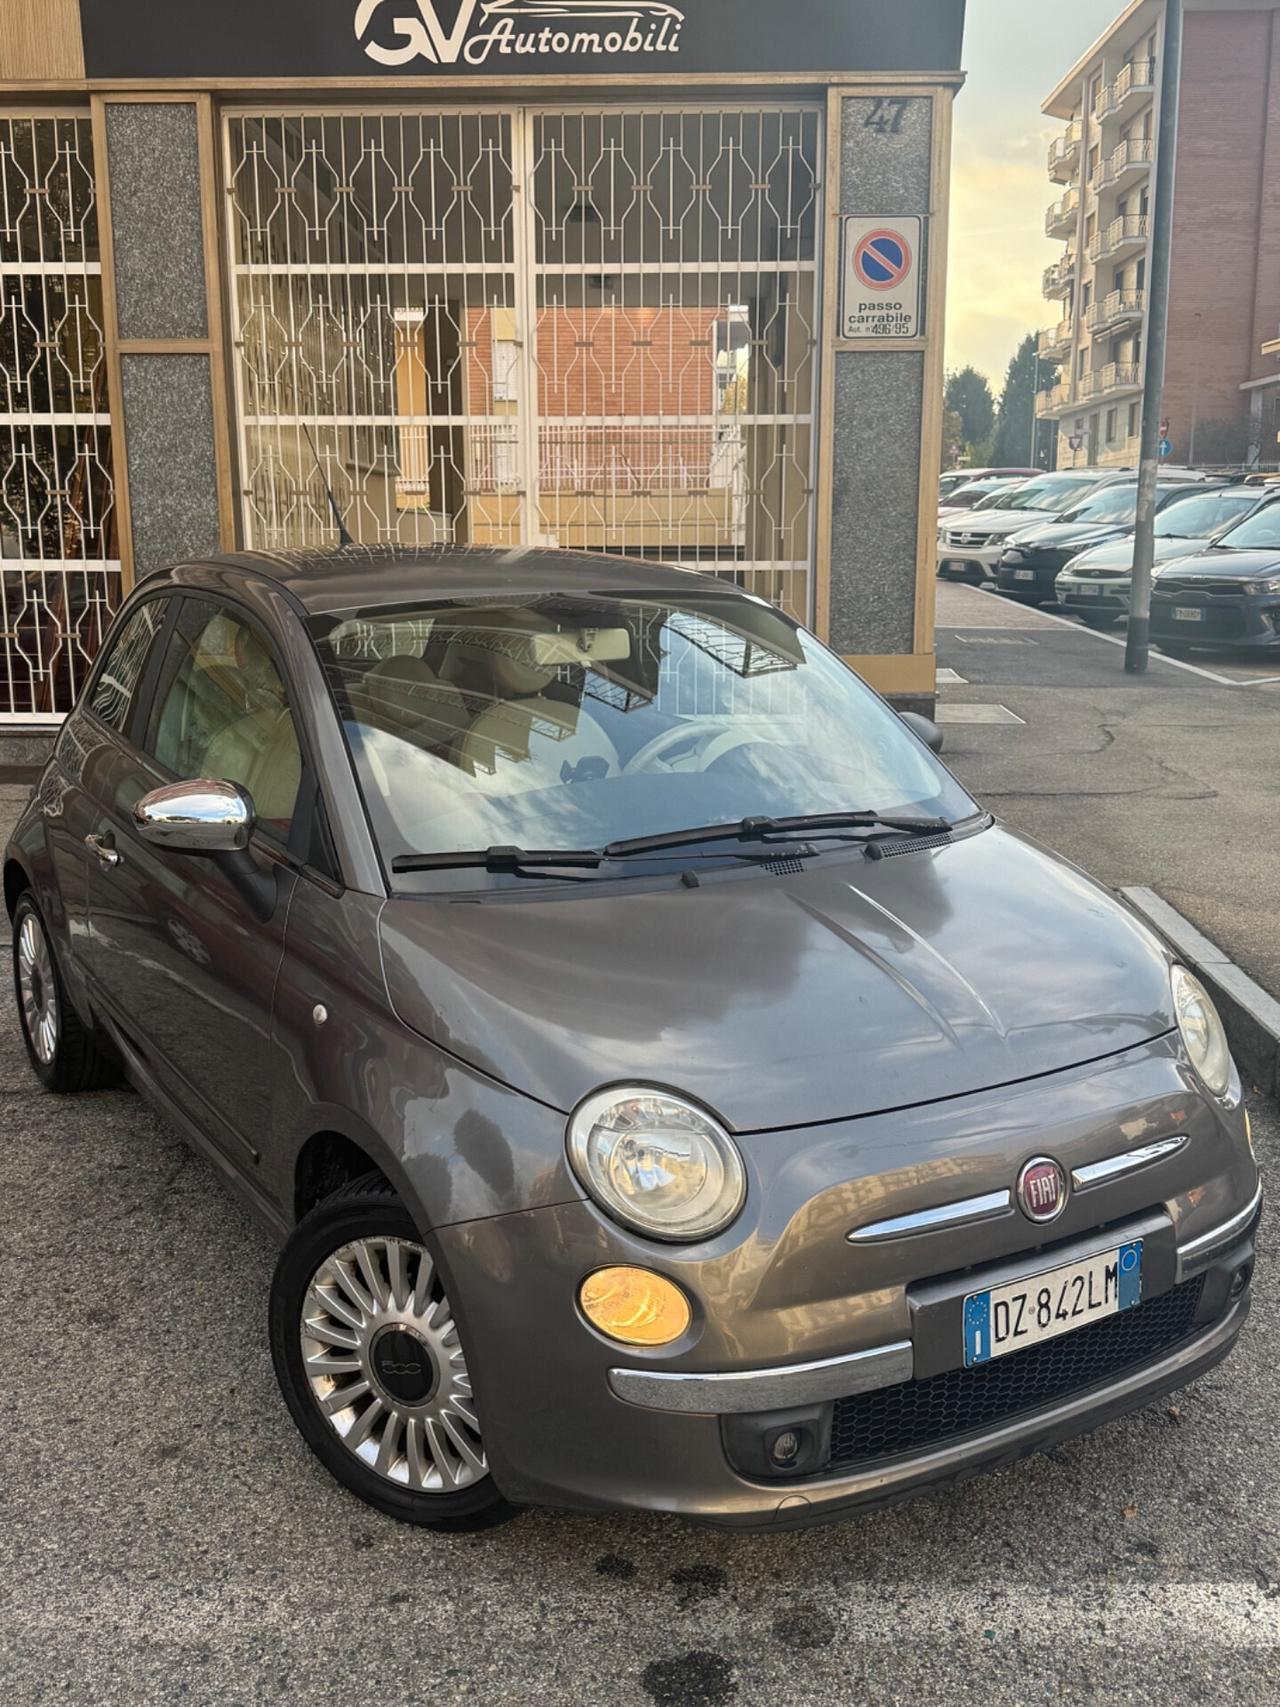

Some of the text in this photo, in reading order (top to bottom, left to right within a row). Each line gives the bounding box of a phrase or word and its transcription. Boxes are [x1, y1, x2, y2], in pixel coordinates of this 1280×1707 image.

[354, 0, 681, 66] GV Automobili
[864, 97, 908, 132] 47
[848, 312, 912, 323] carrabile
[858, 302, 902, 313] passo
[1030, 1173, 1056, 1208] FIAT
[382, 1360, 422, 1375] 500
